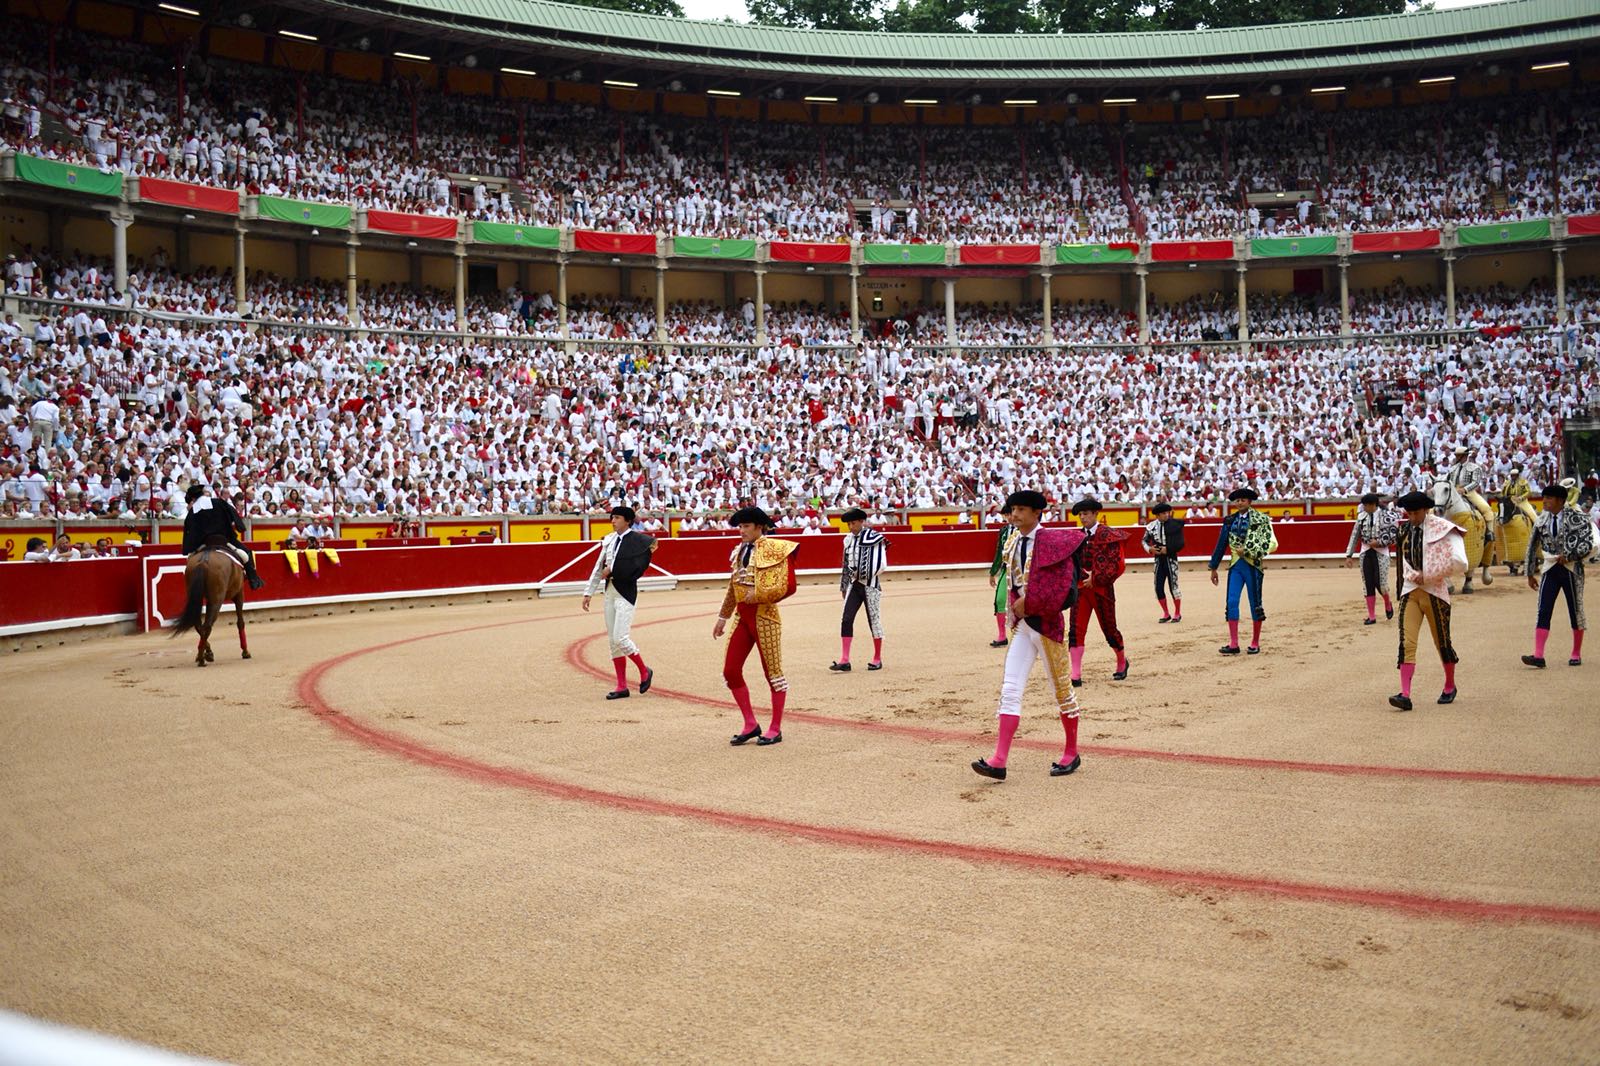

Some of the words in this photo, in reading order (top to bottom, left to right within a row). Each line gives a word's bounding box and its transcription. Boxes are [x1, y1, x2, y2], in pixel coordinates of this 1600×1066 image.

[1347, 508, 1356, 520] 4
[542, 527, 551, 541] 3
[5, 538, 15, 559] 2
